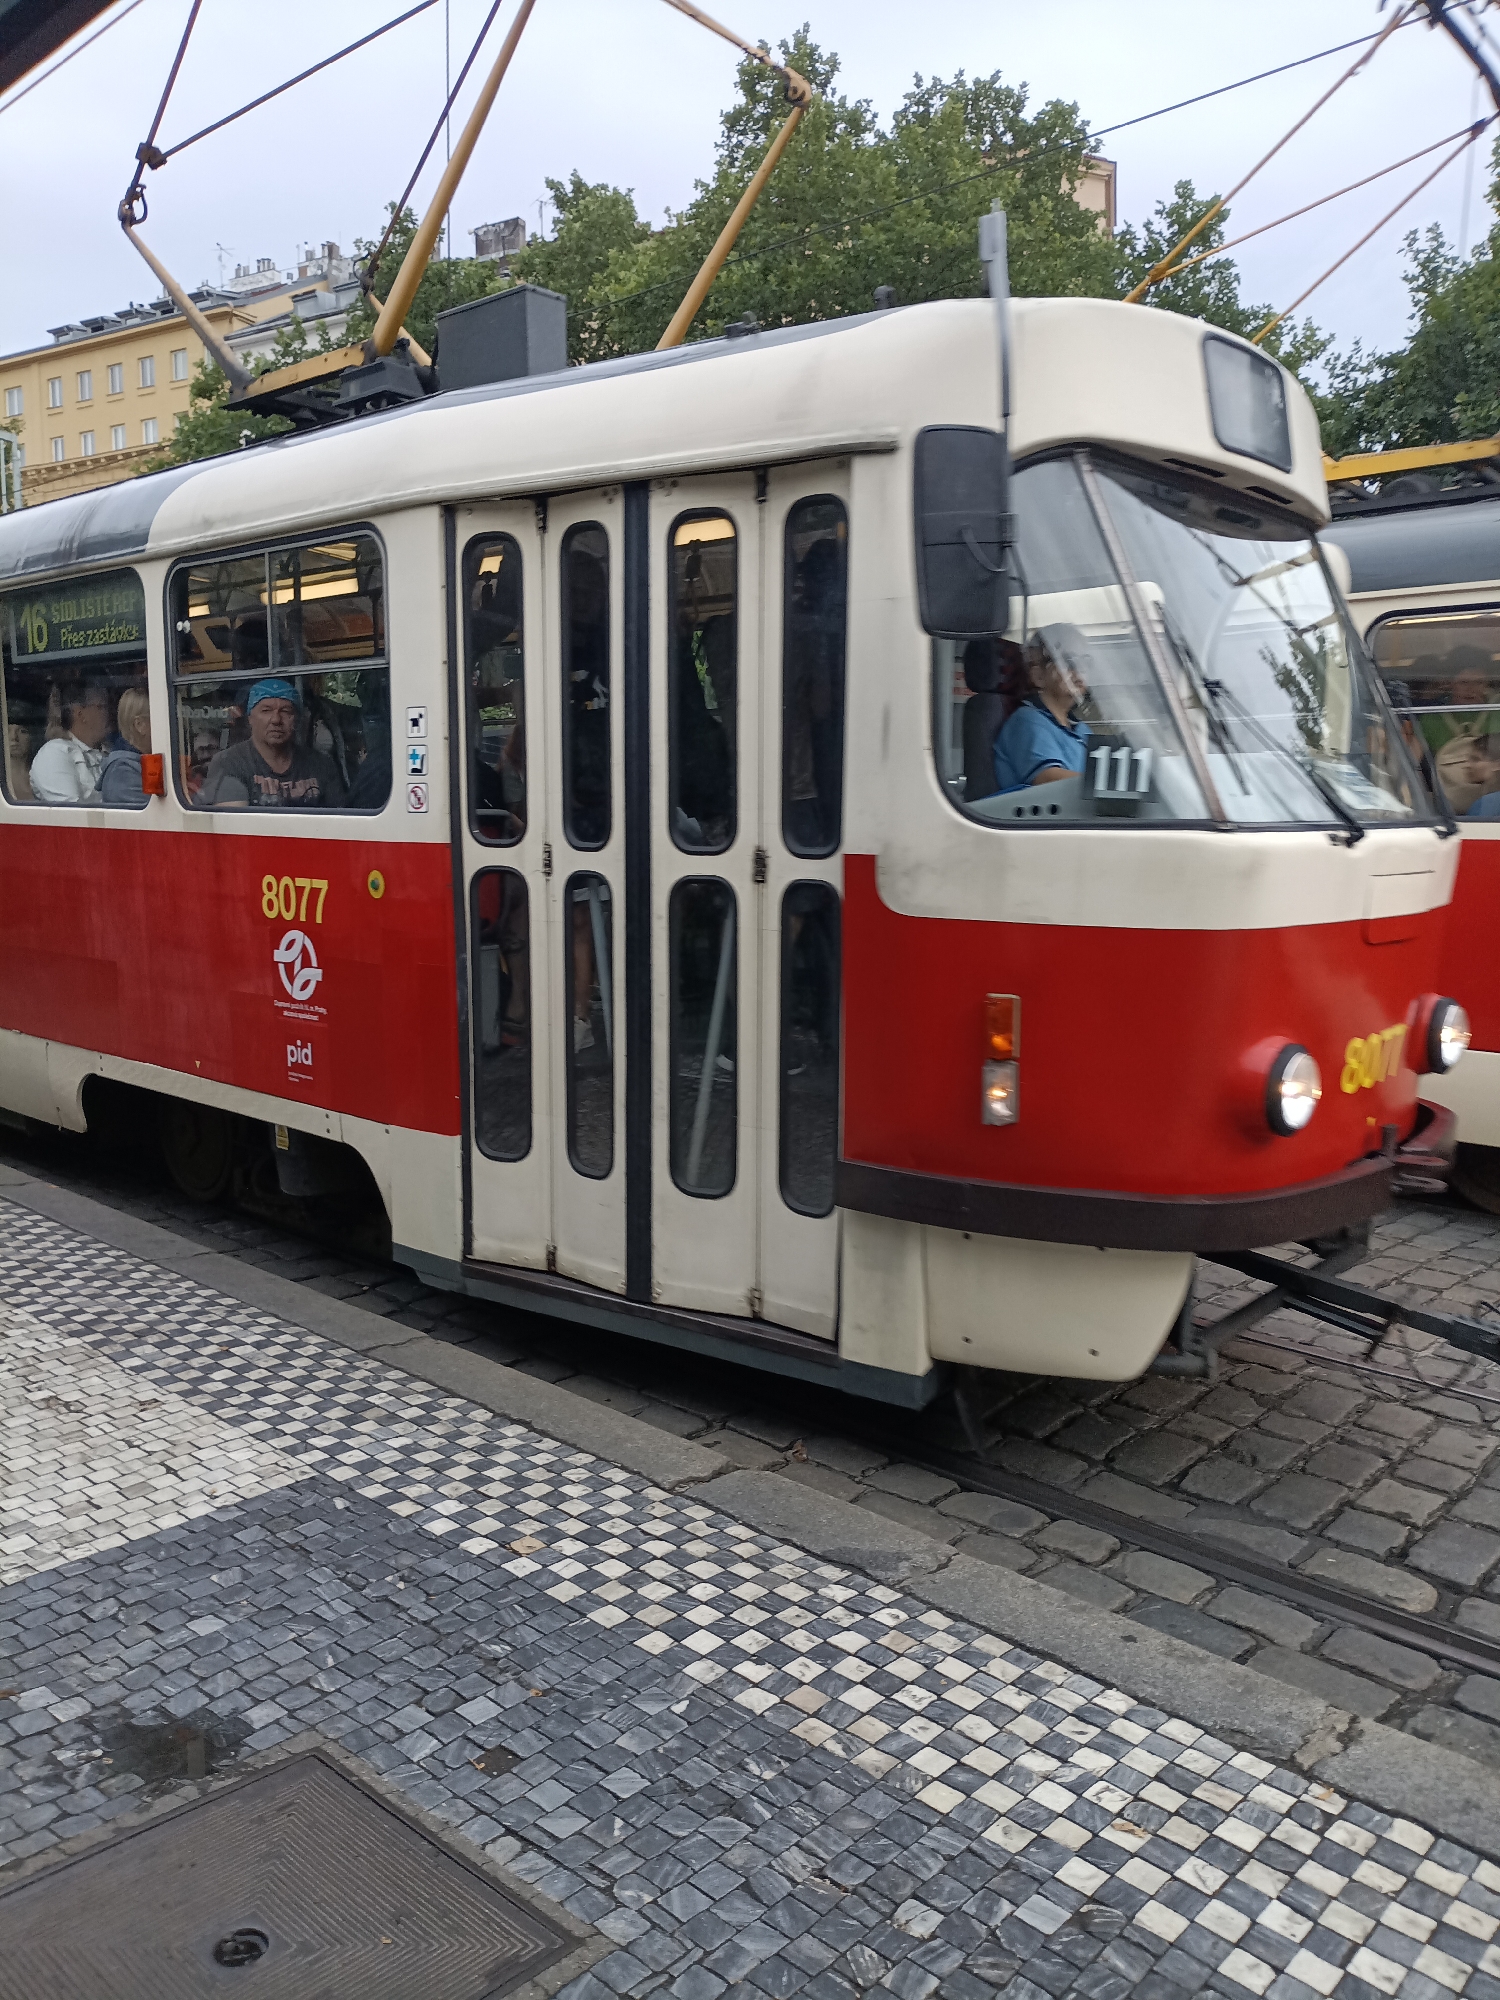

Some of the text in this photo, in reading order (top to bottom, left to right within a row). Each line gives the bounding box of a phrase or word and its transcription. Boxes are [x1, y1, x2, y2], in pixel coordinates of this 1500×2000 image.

[20, 602, 48, 653] 16
[60, 624, 86, 649] Přes
[262, 874, 329, 924] 8077
[286, 1039, 314, 1067] pid
[1339, 1023, 1408, 1095] 8077
